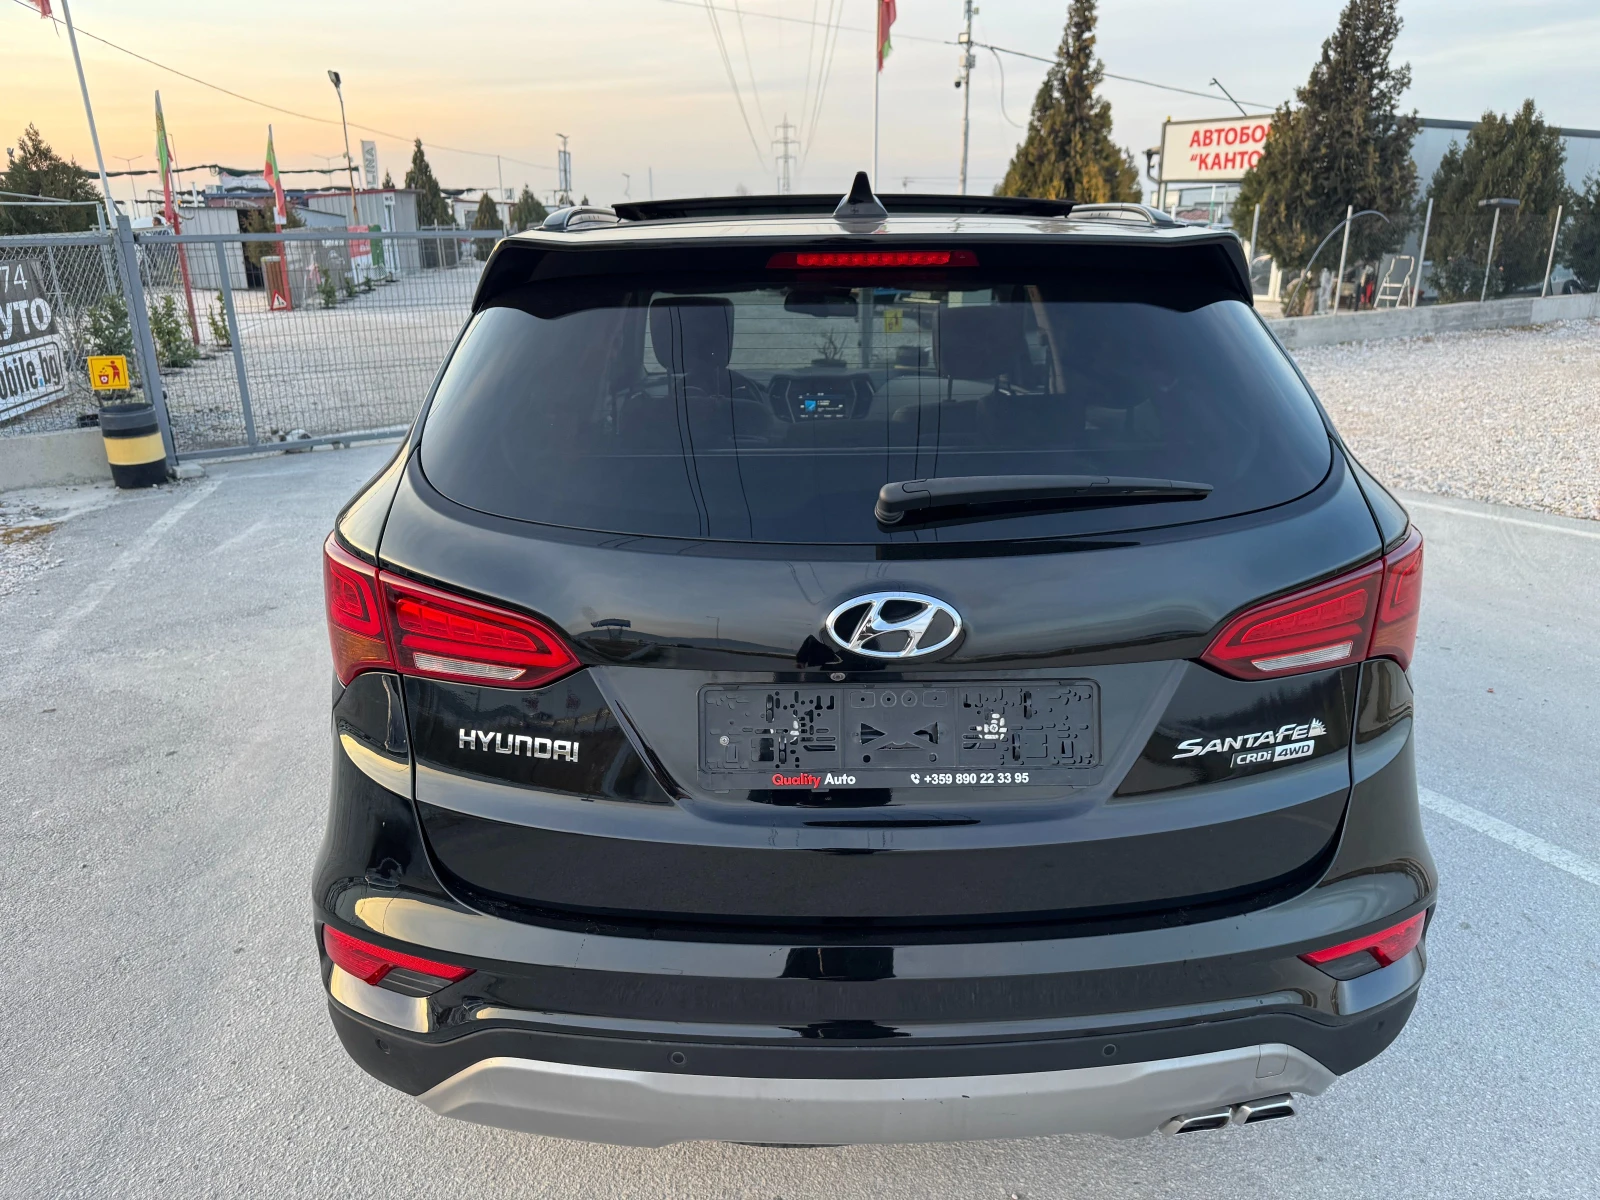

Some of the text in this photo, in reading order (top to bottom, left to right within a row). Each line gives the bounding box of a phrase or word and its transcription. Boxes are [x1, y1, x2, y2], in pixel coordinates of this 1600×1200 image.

[1189, 124, 1272, 148] АВТОБО
[364, 147, 377, 190] LINA
[458, 728, 580, 763] HYUNDAI
[1236, 744, 1311, 765] CRDi 4WD
[771, 772, 857, 789] Quality Auto
[923, 772, 1030, 785] +359 890 22 33 95
